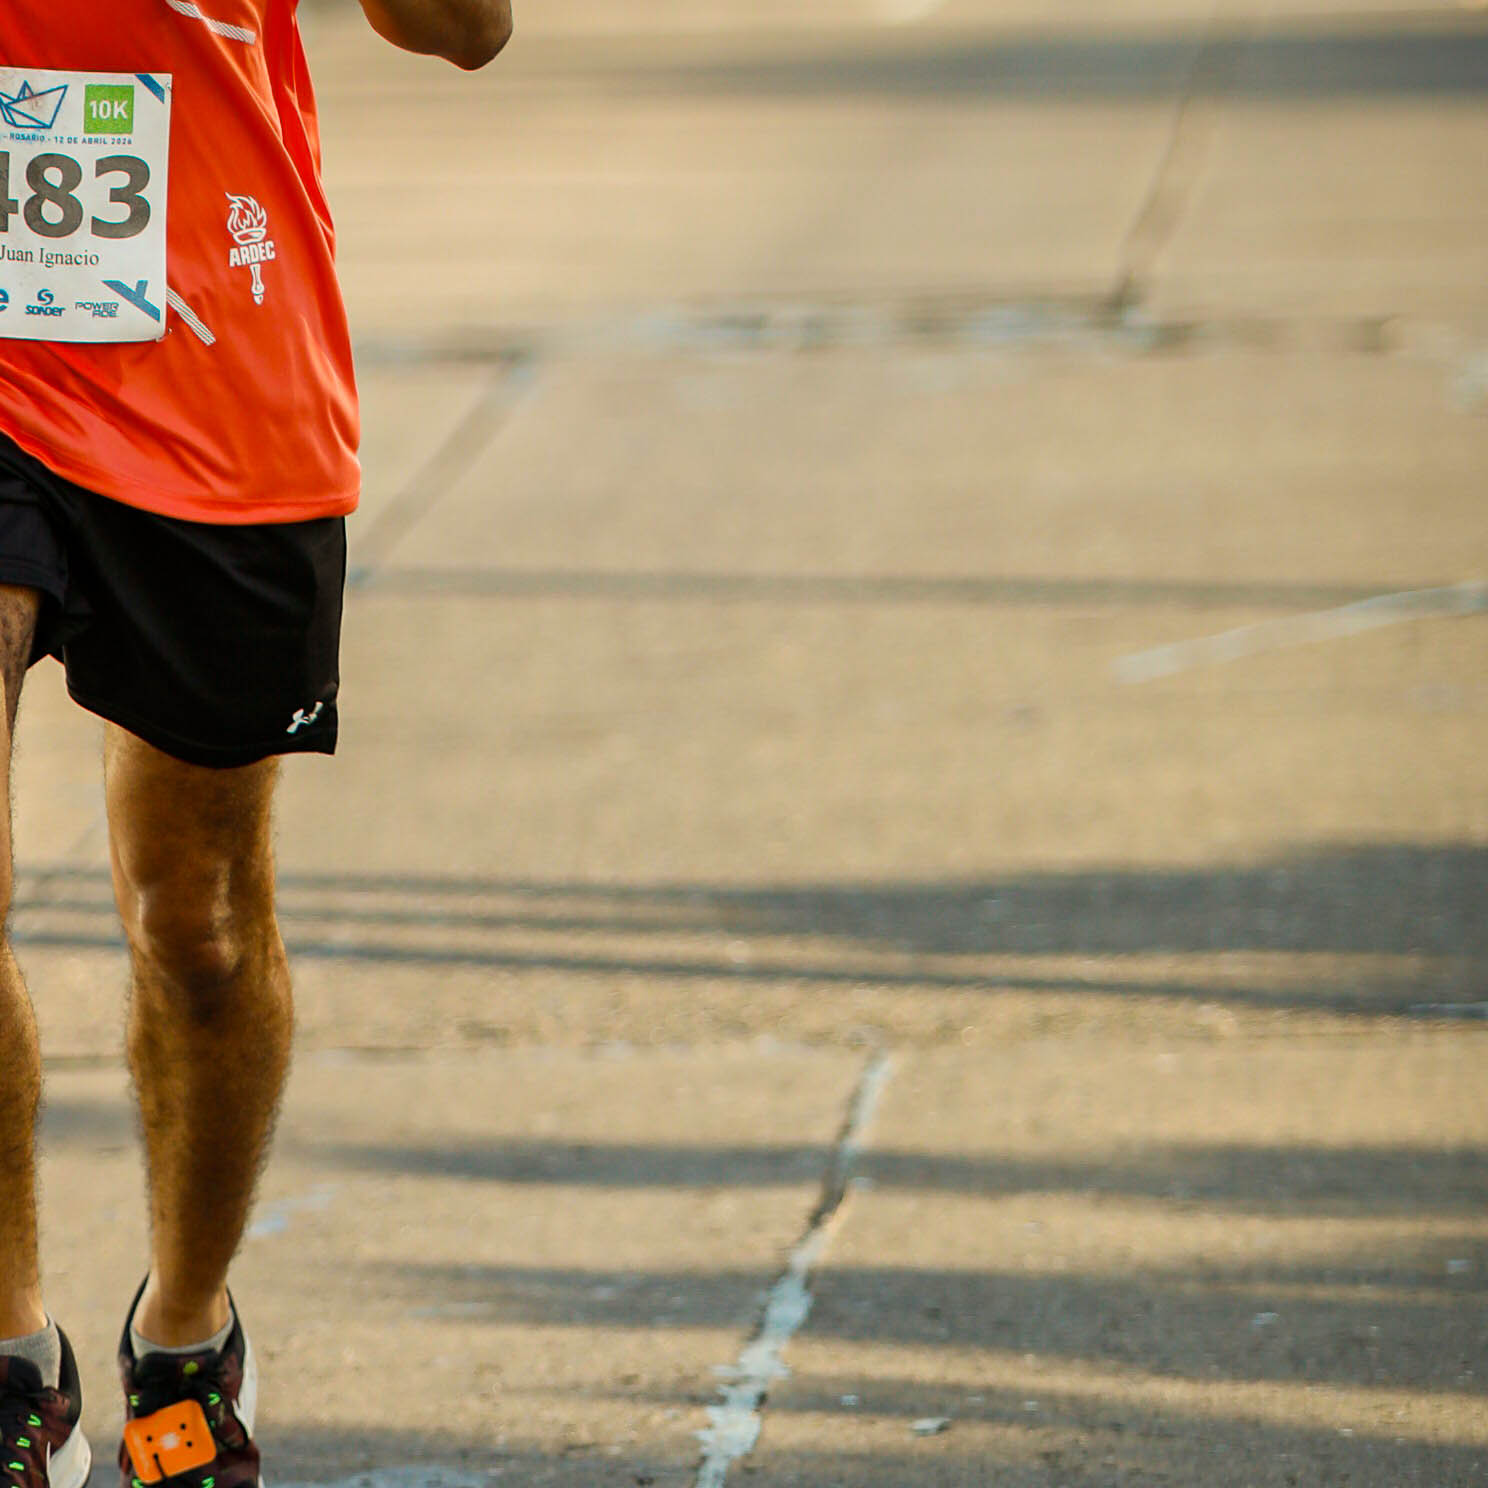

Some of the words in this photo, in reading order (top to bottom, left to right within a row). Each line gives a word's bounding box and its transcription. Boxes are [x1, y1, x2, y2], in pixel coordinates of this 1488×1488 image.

[89, 100, 127, 120] 10K
[9, 132, 45, 142] ROSARIO
[81, 137, 107, 145] ABRIL
[39, 247, 100, 268] Ignacio
[229, 240, 276, 268] ARDEC
